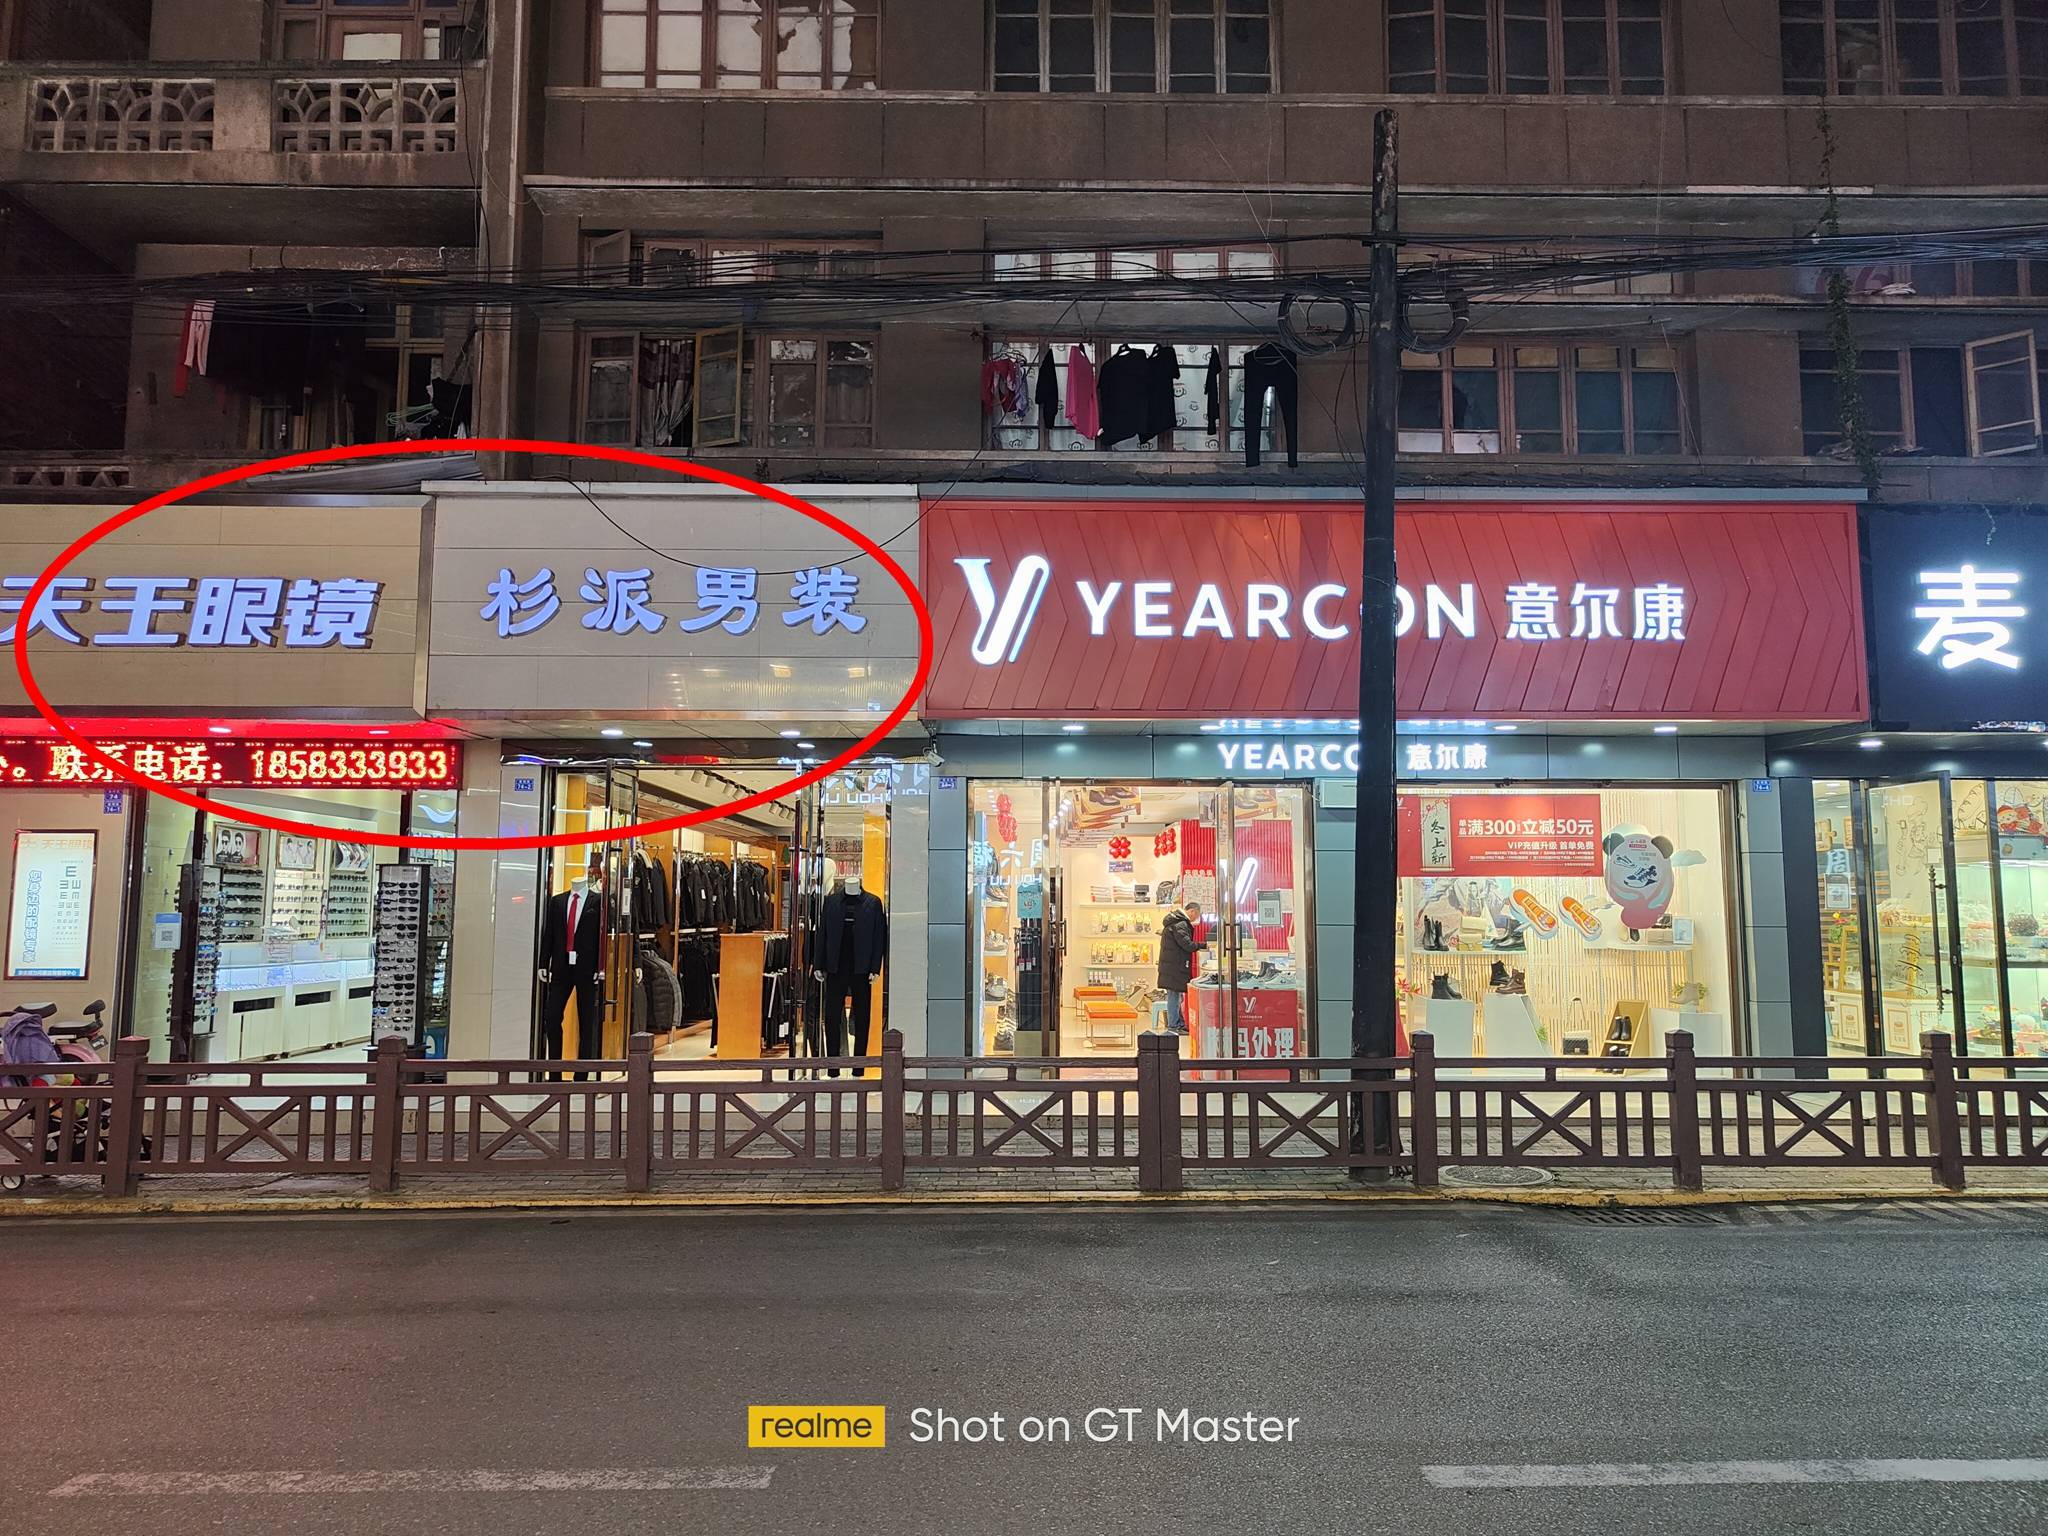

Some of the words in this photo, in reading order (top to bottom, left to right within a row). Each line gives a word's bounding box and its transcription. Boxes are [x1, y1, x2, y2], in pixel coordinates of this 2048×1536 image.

[0, 576, 385, 648] 天王眼镜
[480, 566, 868, 638] 杉派男装
[1505, 582, 1686, 641] 意尔康
[1913, 564, 2026, 670] 麦
[251, 750, 448, 779] 1858333933
[1217, 743, 1360, 771] YEARCO
[1407, 743, 1487, 770] 意尔康
